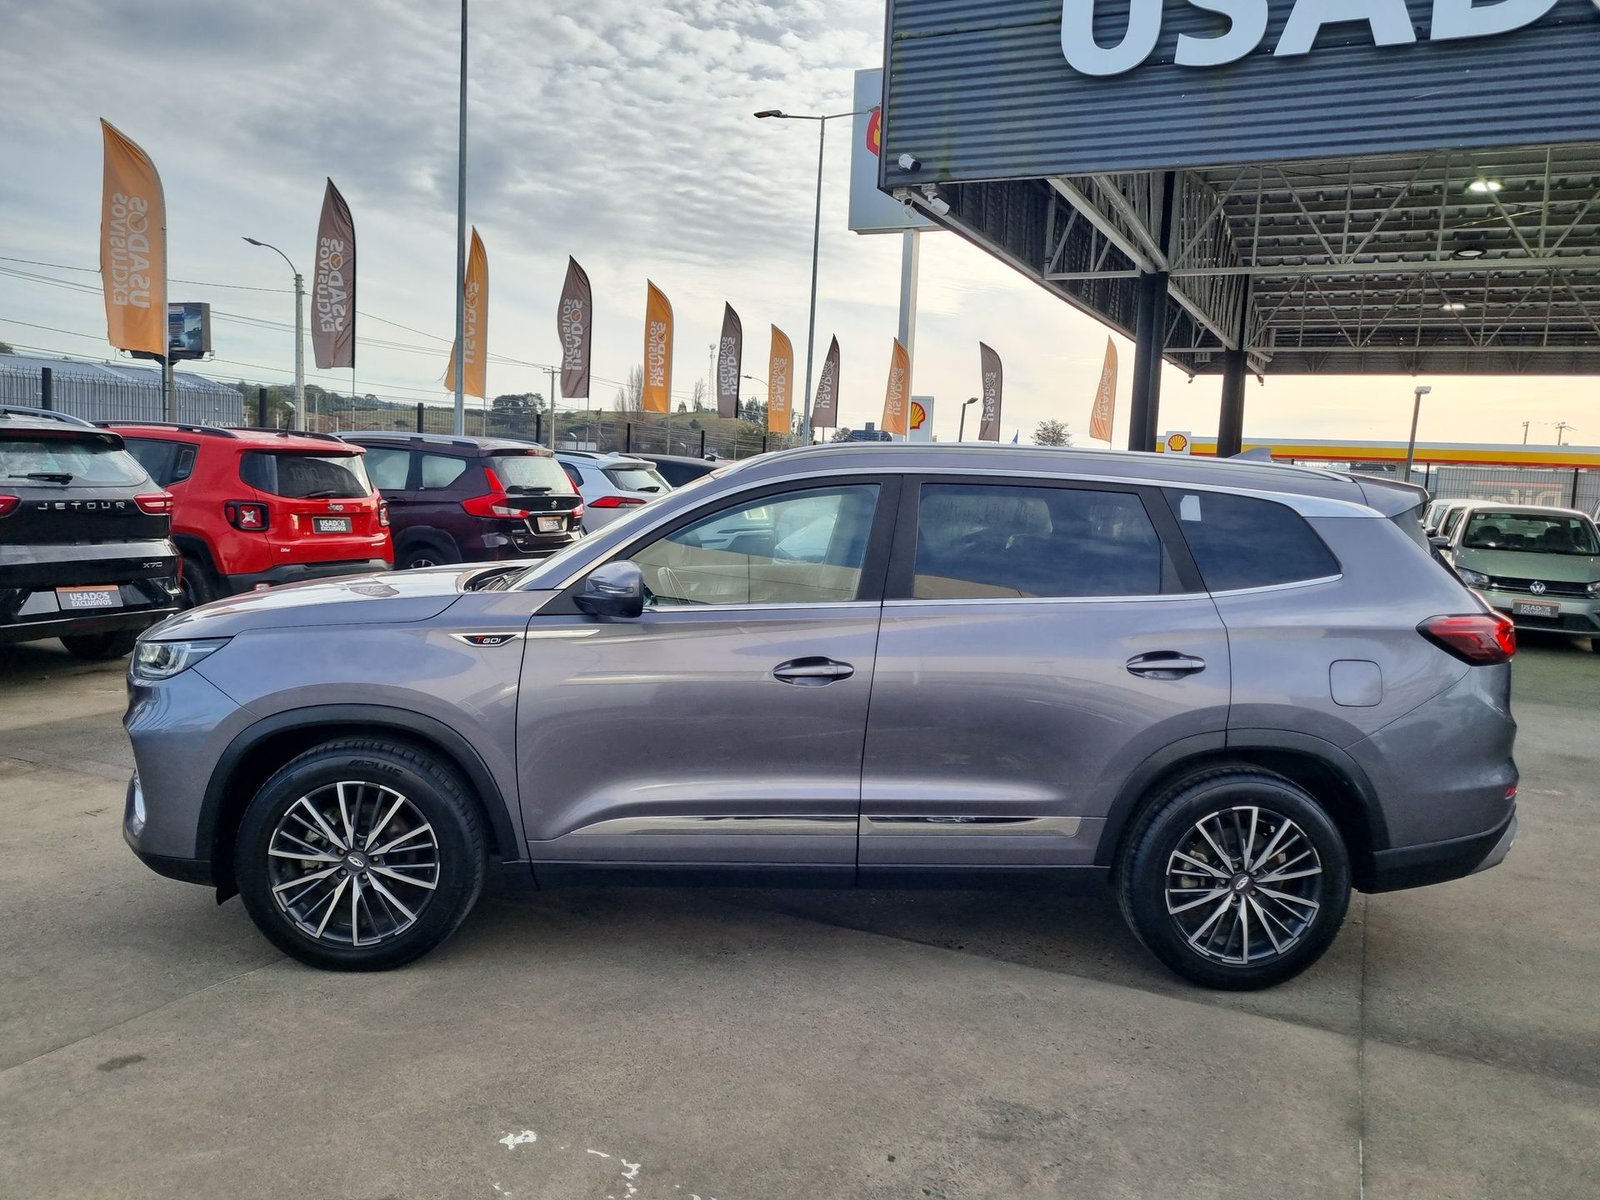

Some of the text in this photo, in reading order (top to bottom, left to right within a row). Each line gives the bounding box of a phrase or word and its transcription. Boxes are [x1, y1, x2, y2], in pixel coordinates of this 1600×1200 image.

[1061, 0, 1600, 76] USA
[37, 501, 126, 511] JETOUR
[328, 503, 344, 512] Jeep
[319, 519, 346, 527] USADOS
[142, 561, 163, 569] X70
[69, 591, 110, 601] USADOS
[71, 599, 113, 607] EXCLUSIVOS
